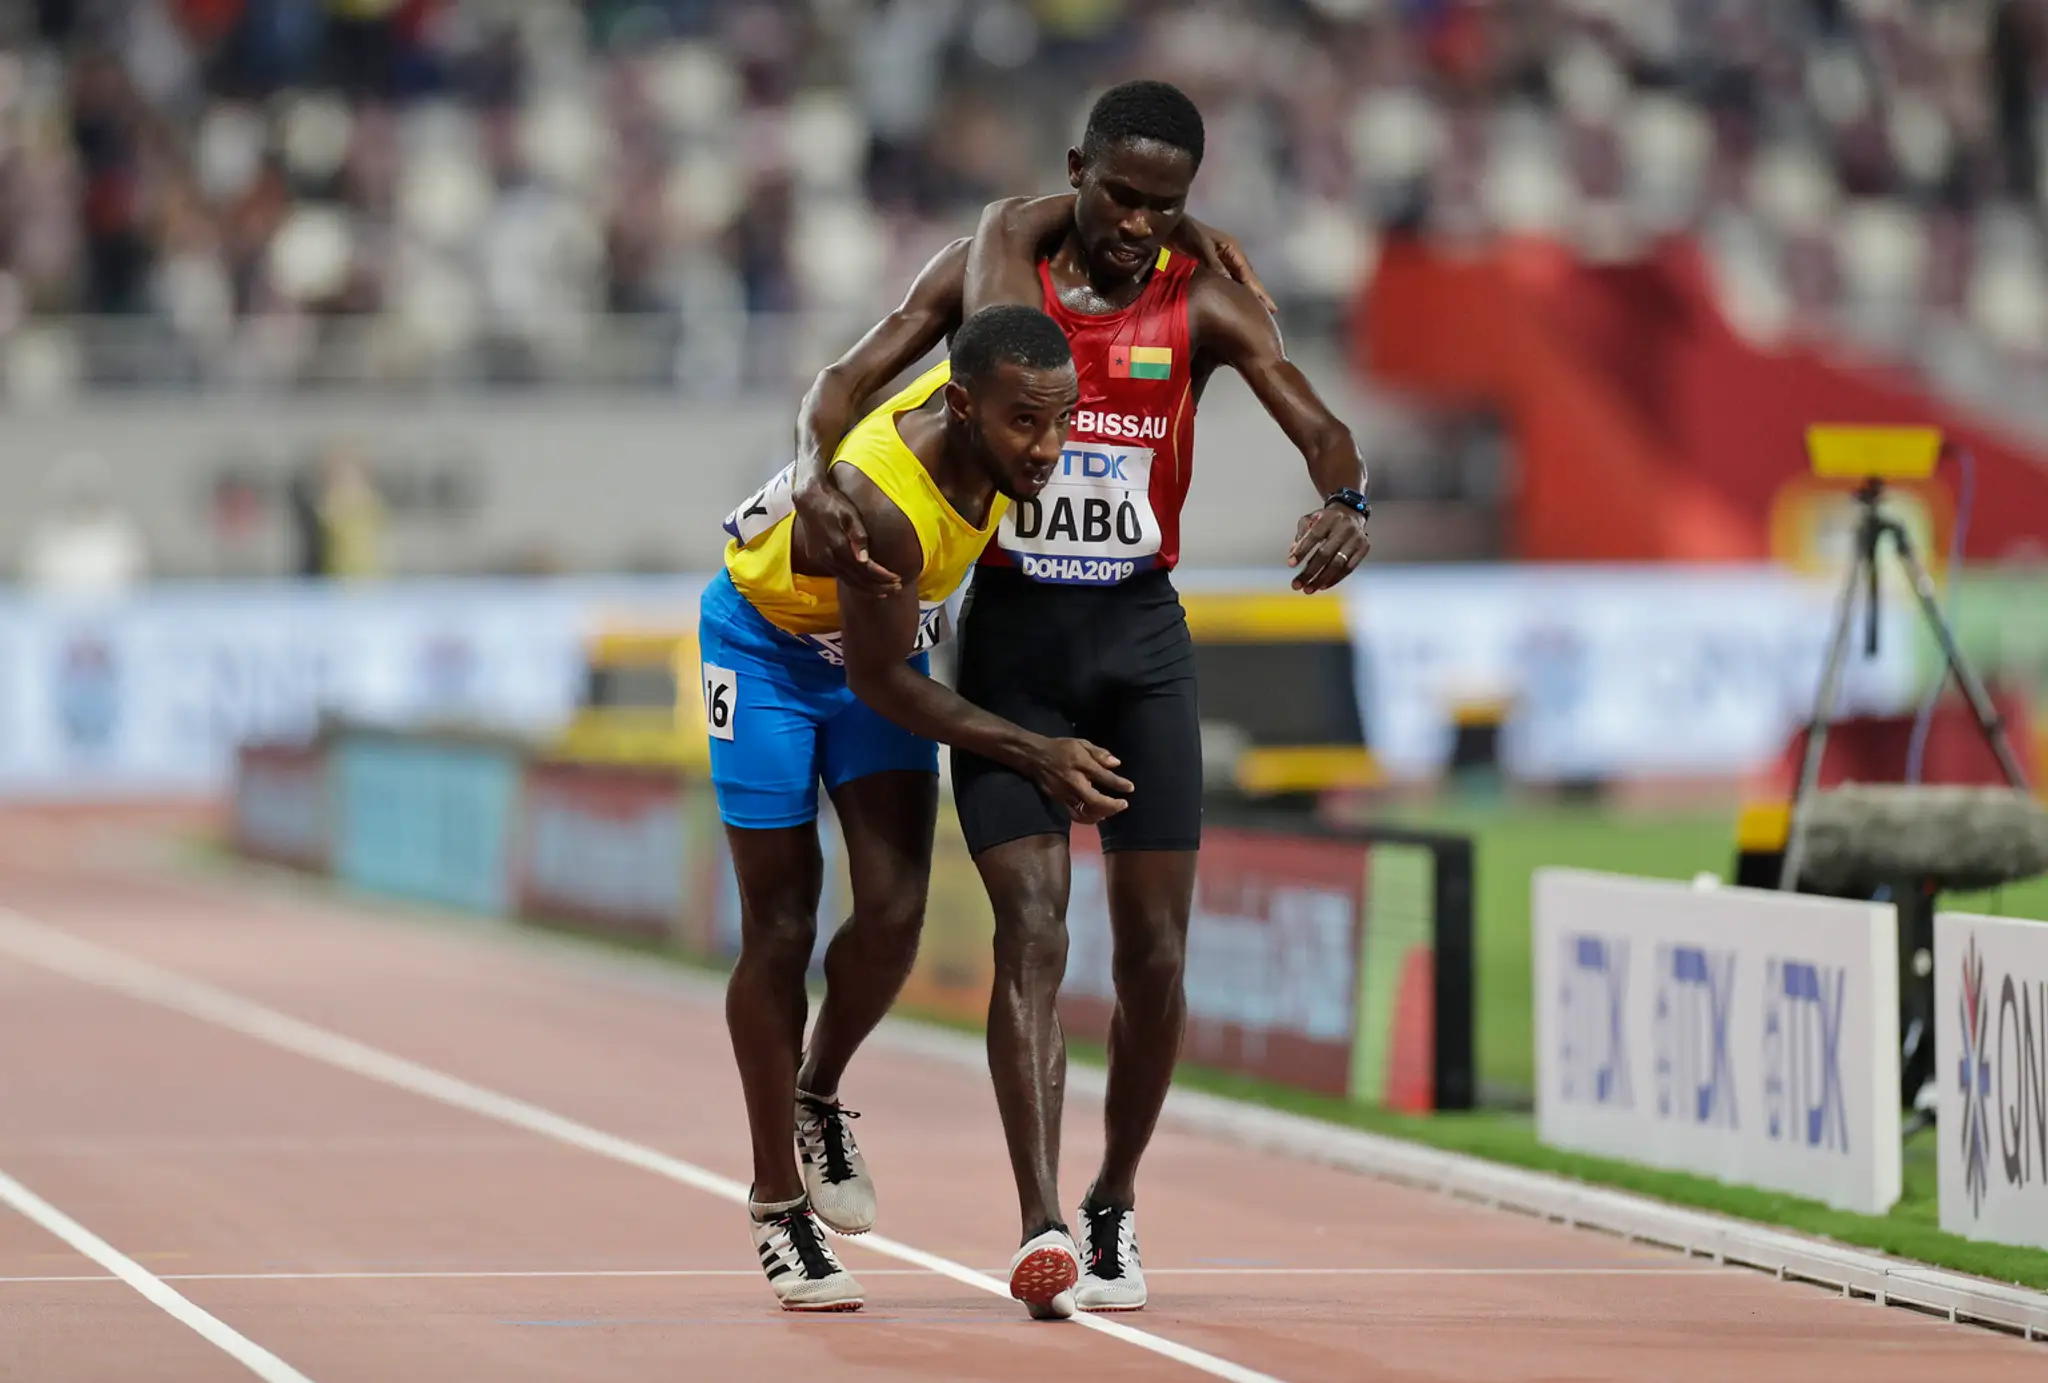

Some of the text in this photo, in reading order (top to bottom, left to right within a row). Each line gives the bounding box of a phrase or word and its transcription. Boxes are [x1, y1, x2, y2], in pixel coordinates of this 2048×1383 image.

[1060, 450, 1128, 481] TDK
[1014, 491, 1142, 545] DABÓ
[1022, 556, 1135, 581] DOHA2019
[708, 680, 729, 728] 16
[1999, 972, 2048, 1190] QN
